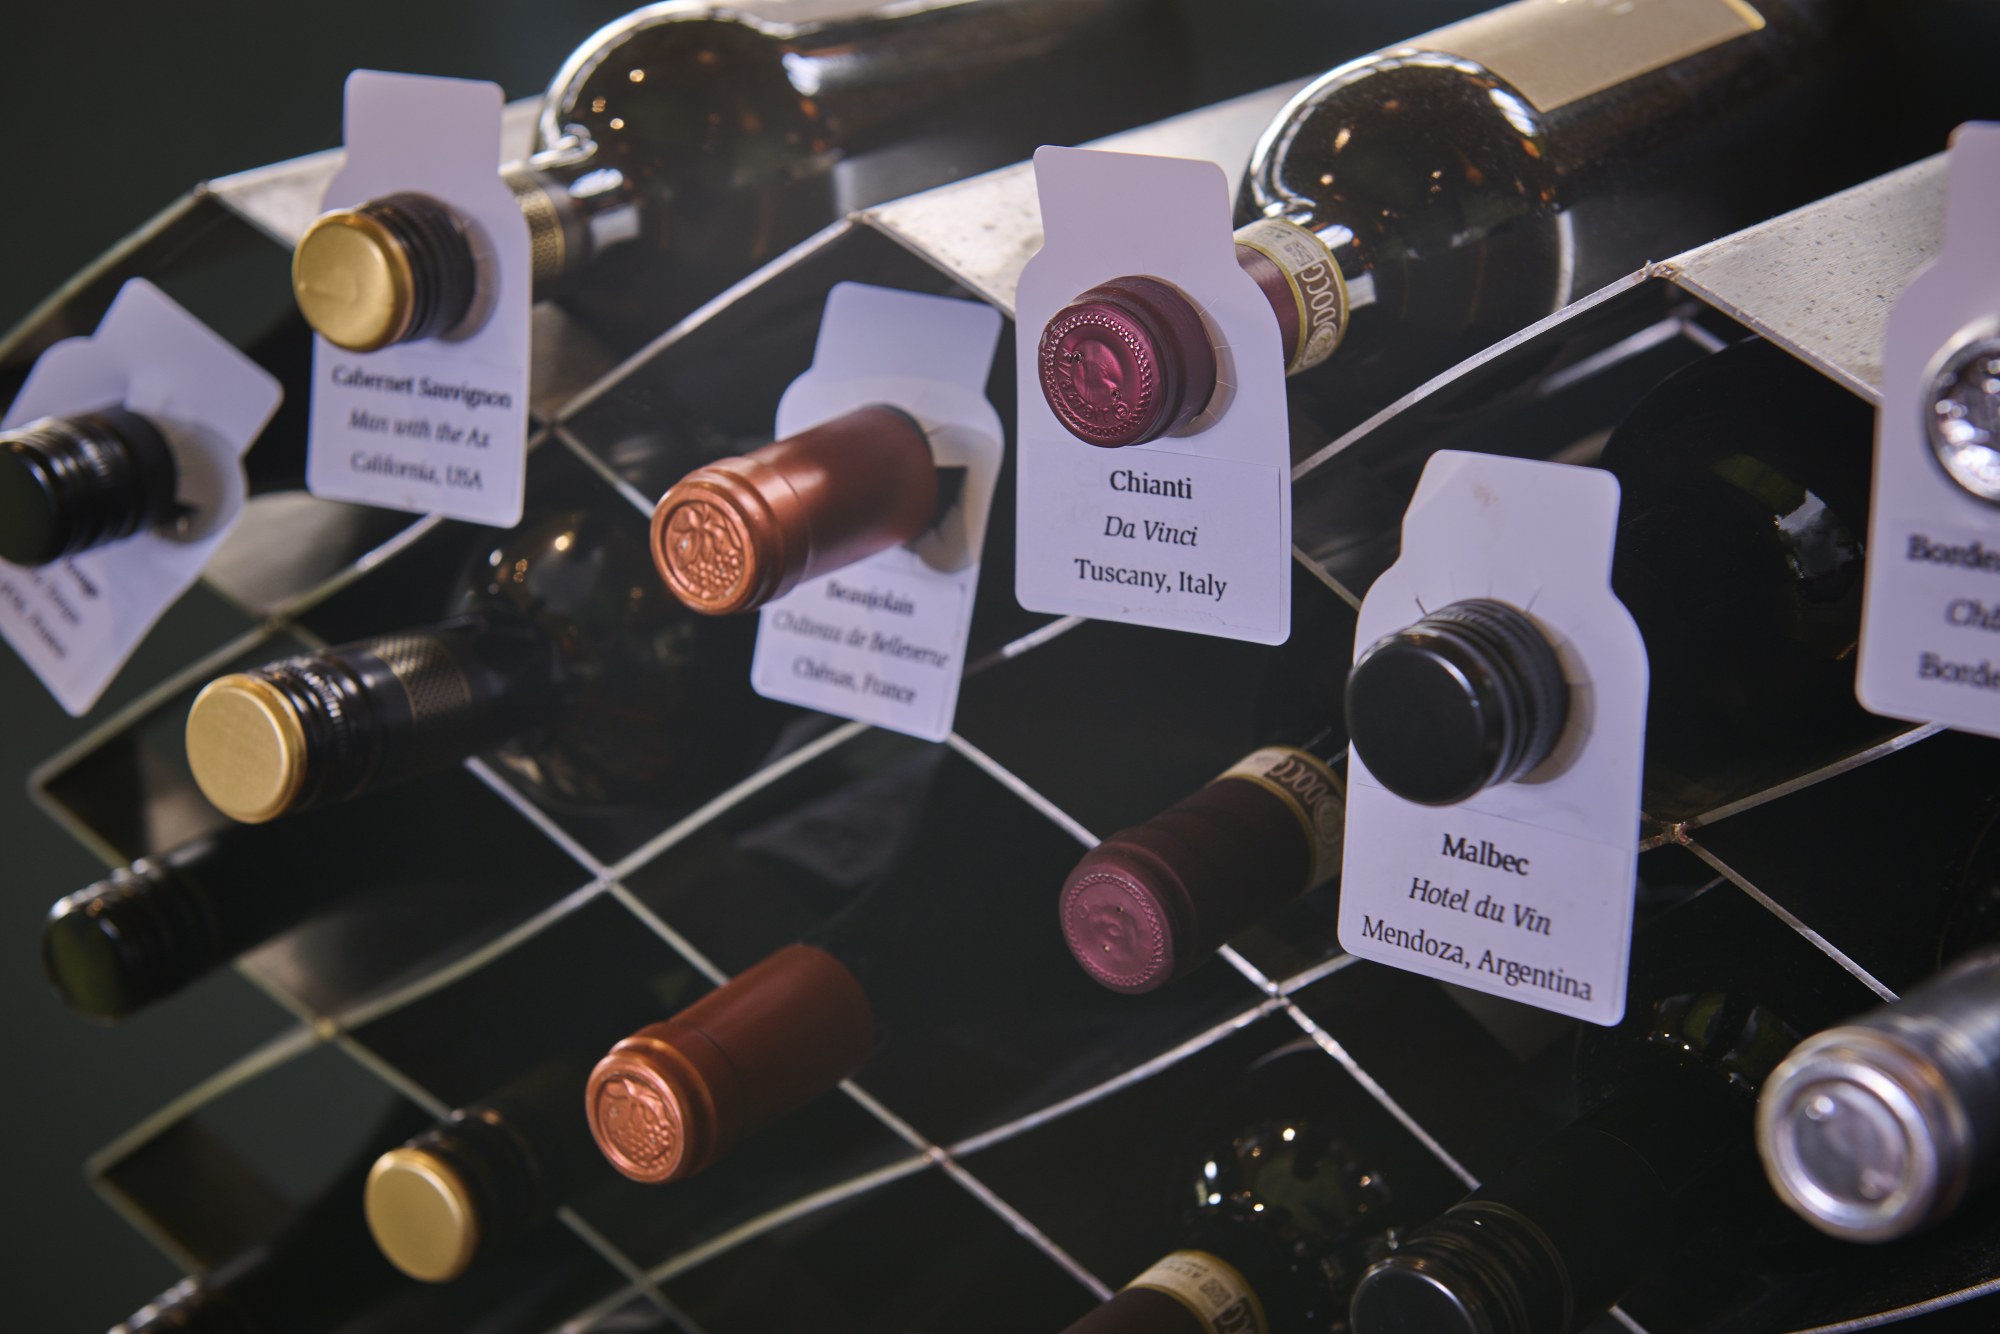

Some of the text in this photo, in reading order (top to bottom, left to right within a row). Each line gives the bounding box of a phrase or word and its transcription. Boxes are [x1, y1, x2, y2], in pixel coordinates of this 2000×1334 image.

[331, 364, 512, 409] Cabernet Sauvignon
[434, 422, 463, 444] the
[350, 450, 484, 489] California, USA
[1109, 469, 1193, 500] Chianti
[1104, 515, 1198, 547] Da Vinci
[827, 580, 915, 616] Beaujolais
[1074, 558, 1228, 602] Tuscany, Italy
[847, 626, 868, 647] de
[863, 673, 916, 705] France
[1442, 833, 1529, 876] Malbec
[1409, 877, 1553, 936] Hotel du Vin
[1362, 915, 1594, 1002] Mendoza, Argentina
